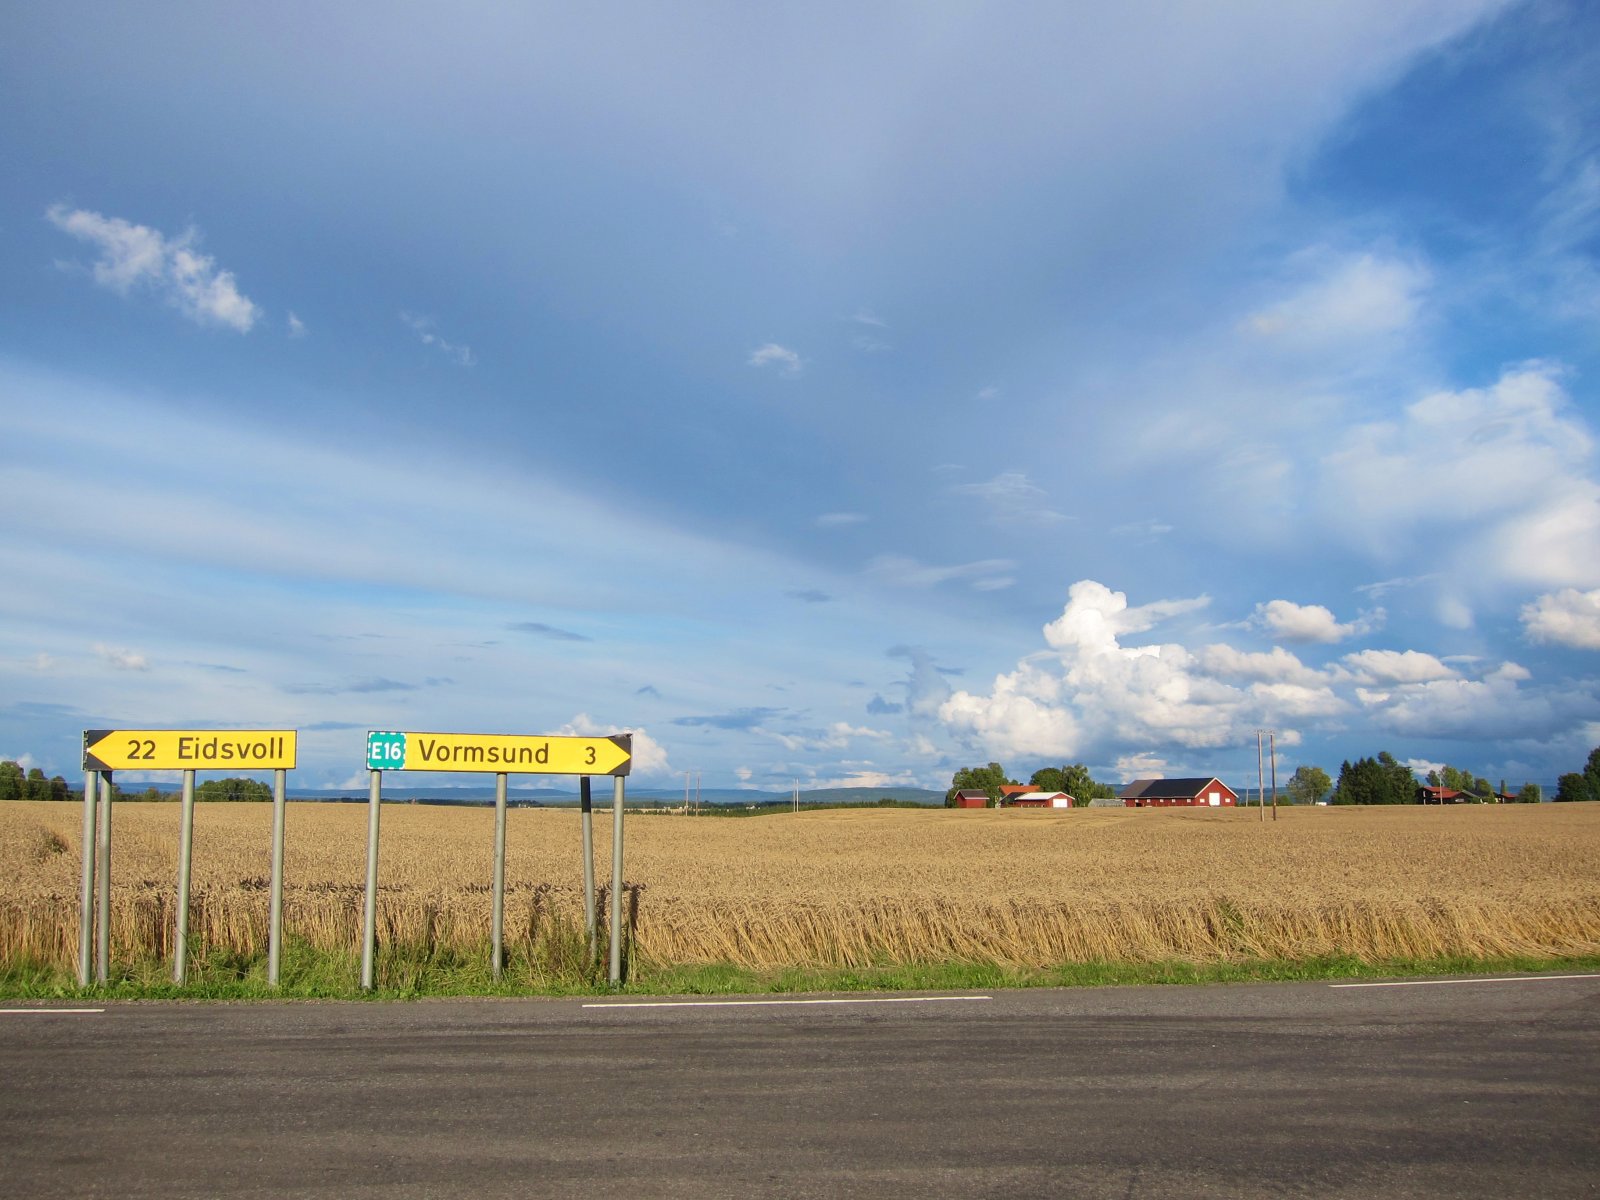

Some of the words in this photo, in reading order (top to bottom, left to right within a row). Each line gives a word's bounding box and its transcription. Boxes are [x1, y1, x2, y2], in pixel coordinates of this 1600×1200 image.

[127, 739, 156, 760] 22
[178, 737, 283, 760] Eidsvoll
[371, 742, 402, 760] E16
[418, 739, 549, 764] Vormsund
[584, 746, 597, 765] 3
